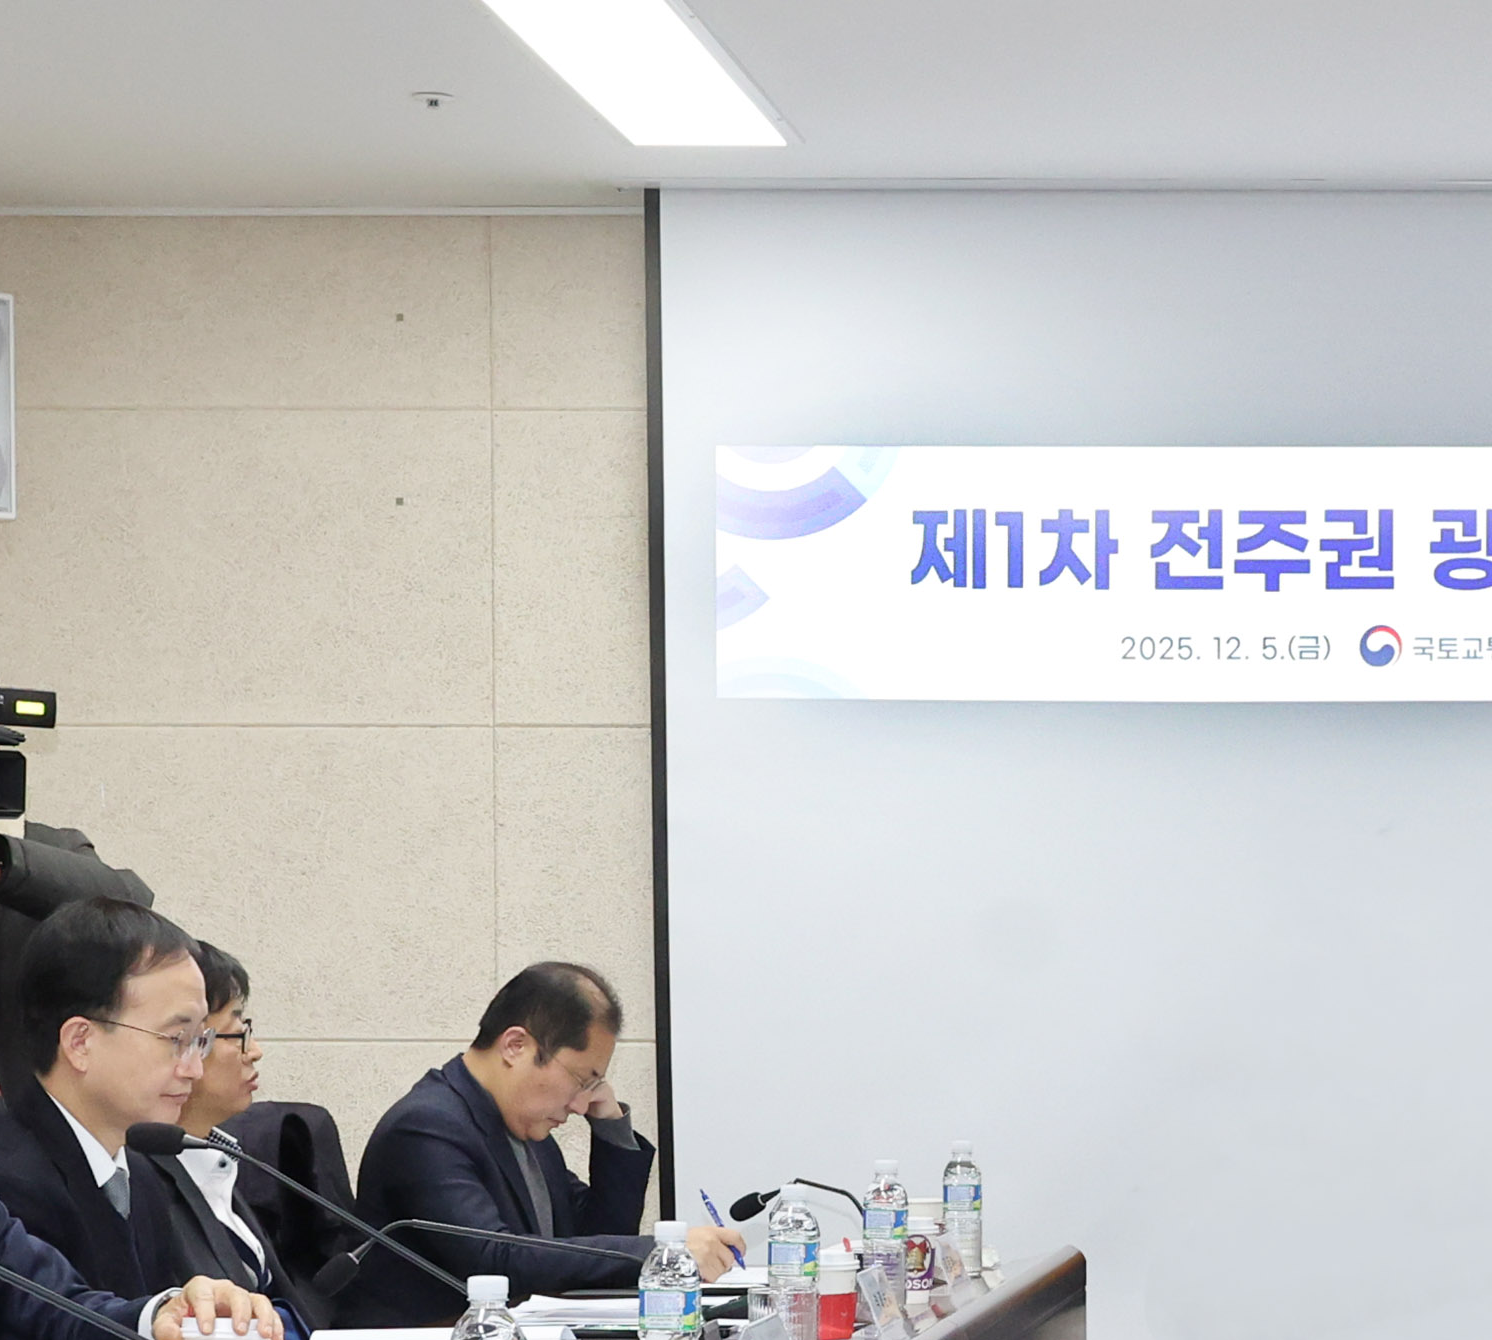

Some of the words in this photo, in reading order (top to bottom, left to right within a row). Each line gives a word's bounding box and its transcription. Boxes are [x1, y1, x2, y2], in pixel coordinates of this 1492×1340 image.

[911, 508, 1118, 590] 제1차
[1150, 508, 1396, 592] 전주권
[1121, 636, 1202, 661] 2025.
[1213, 636, 1250, 661] 12.
[1261, 634, 1332, 663] 5.(금)
